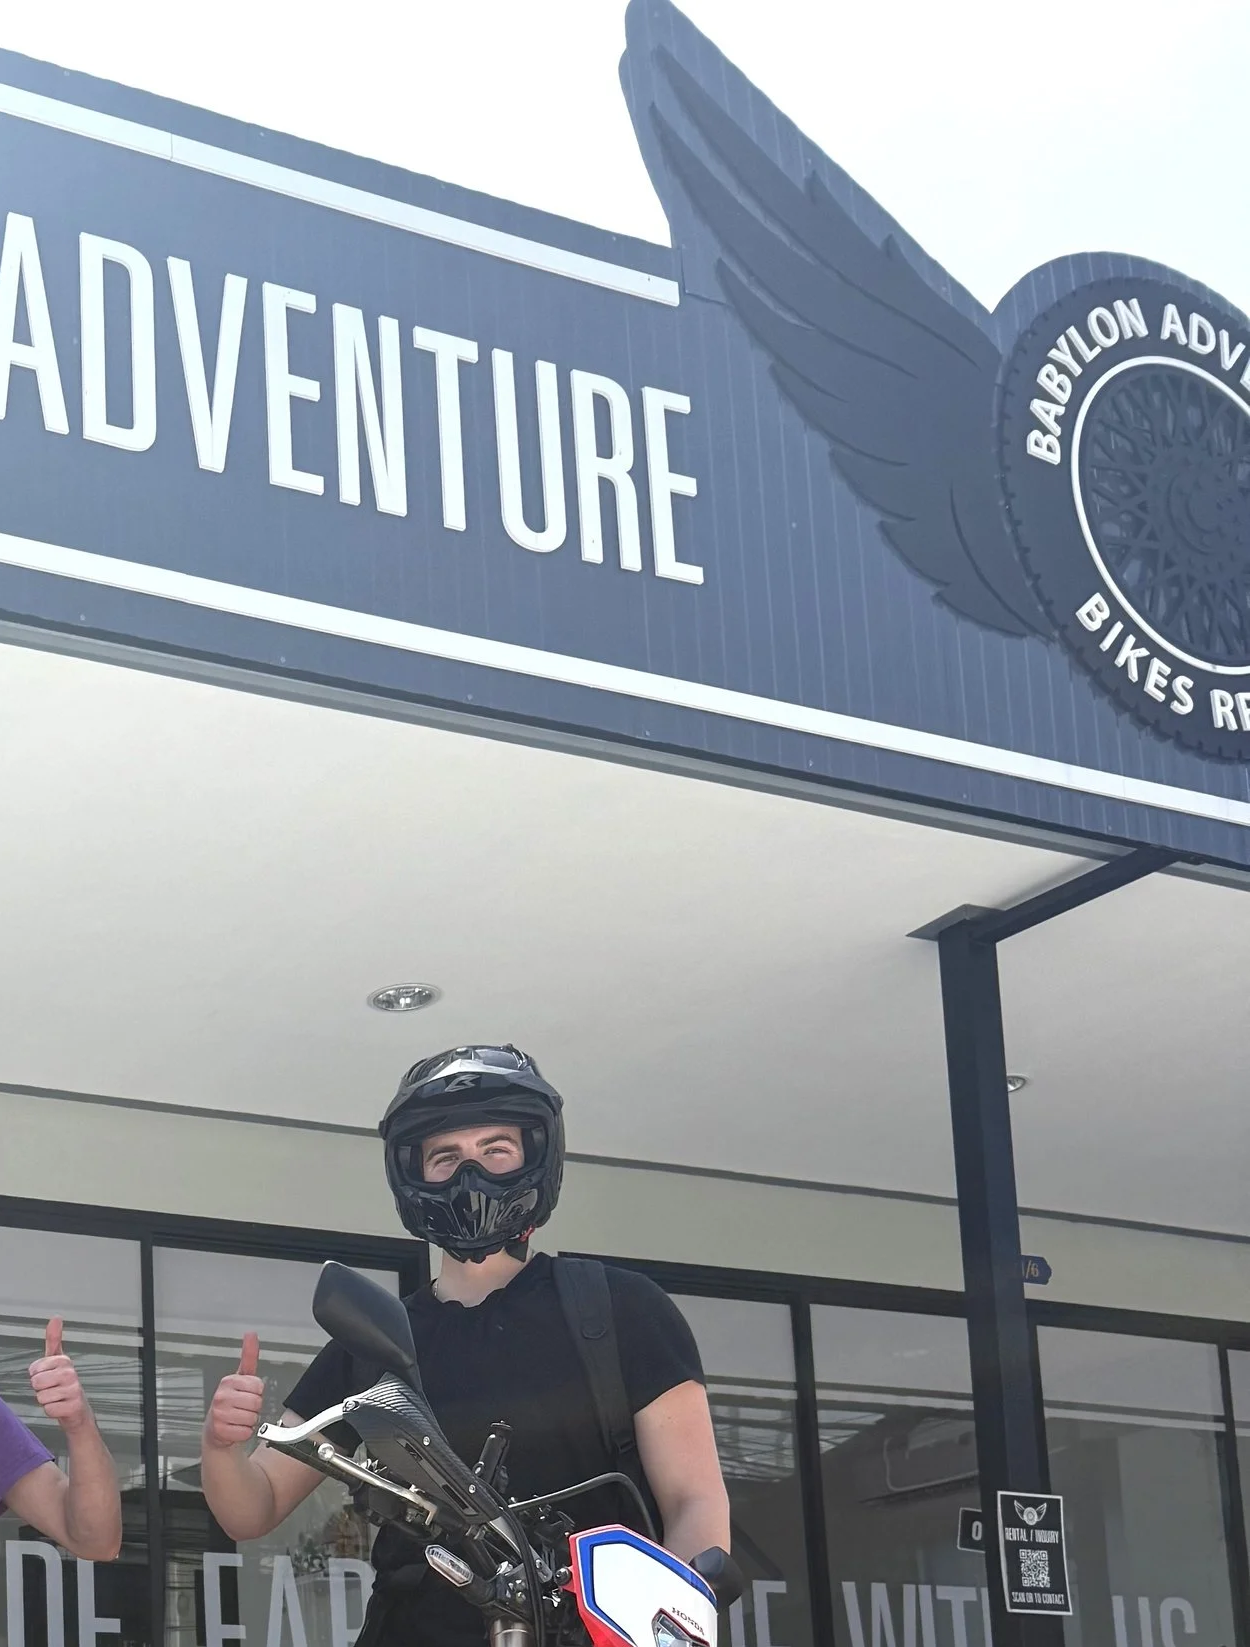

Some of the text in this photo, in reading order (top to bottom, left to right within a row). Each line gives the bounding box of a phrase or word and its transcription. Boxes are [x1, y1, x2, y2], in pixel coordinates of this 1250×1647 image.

[1026, 297, 1149, 465] BABYLON
[1075, 592, 1194, 715] BIKES
[1005, 1527, 1028, 1542] RENTAL
[1011, 1591, 1026, 1603] SCAN
[1042, 1593, 1065, 1605] CONTACT
[671, 1606, 705, 1636] HONDA
